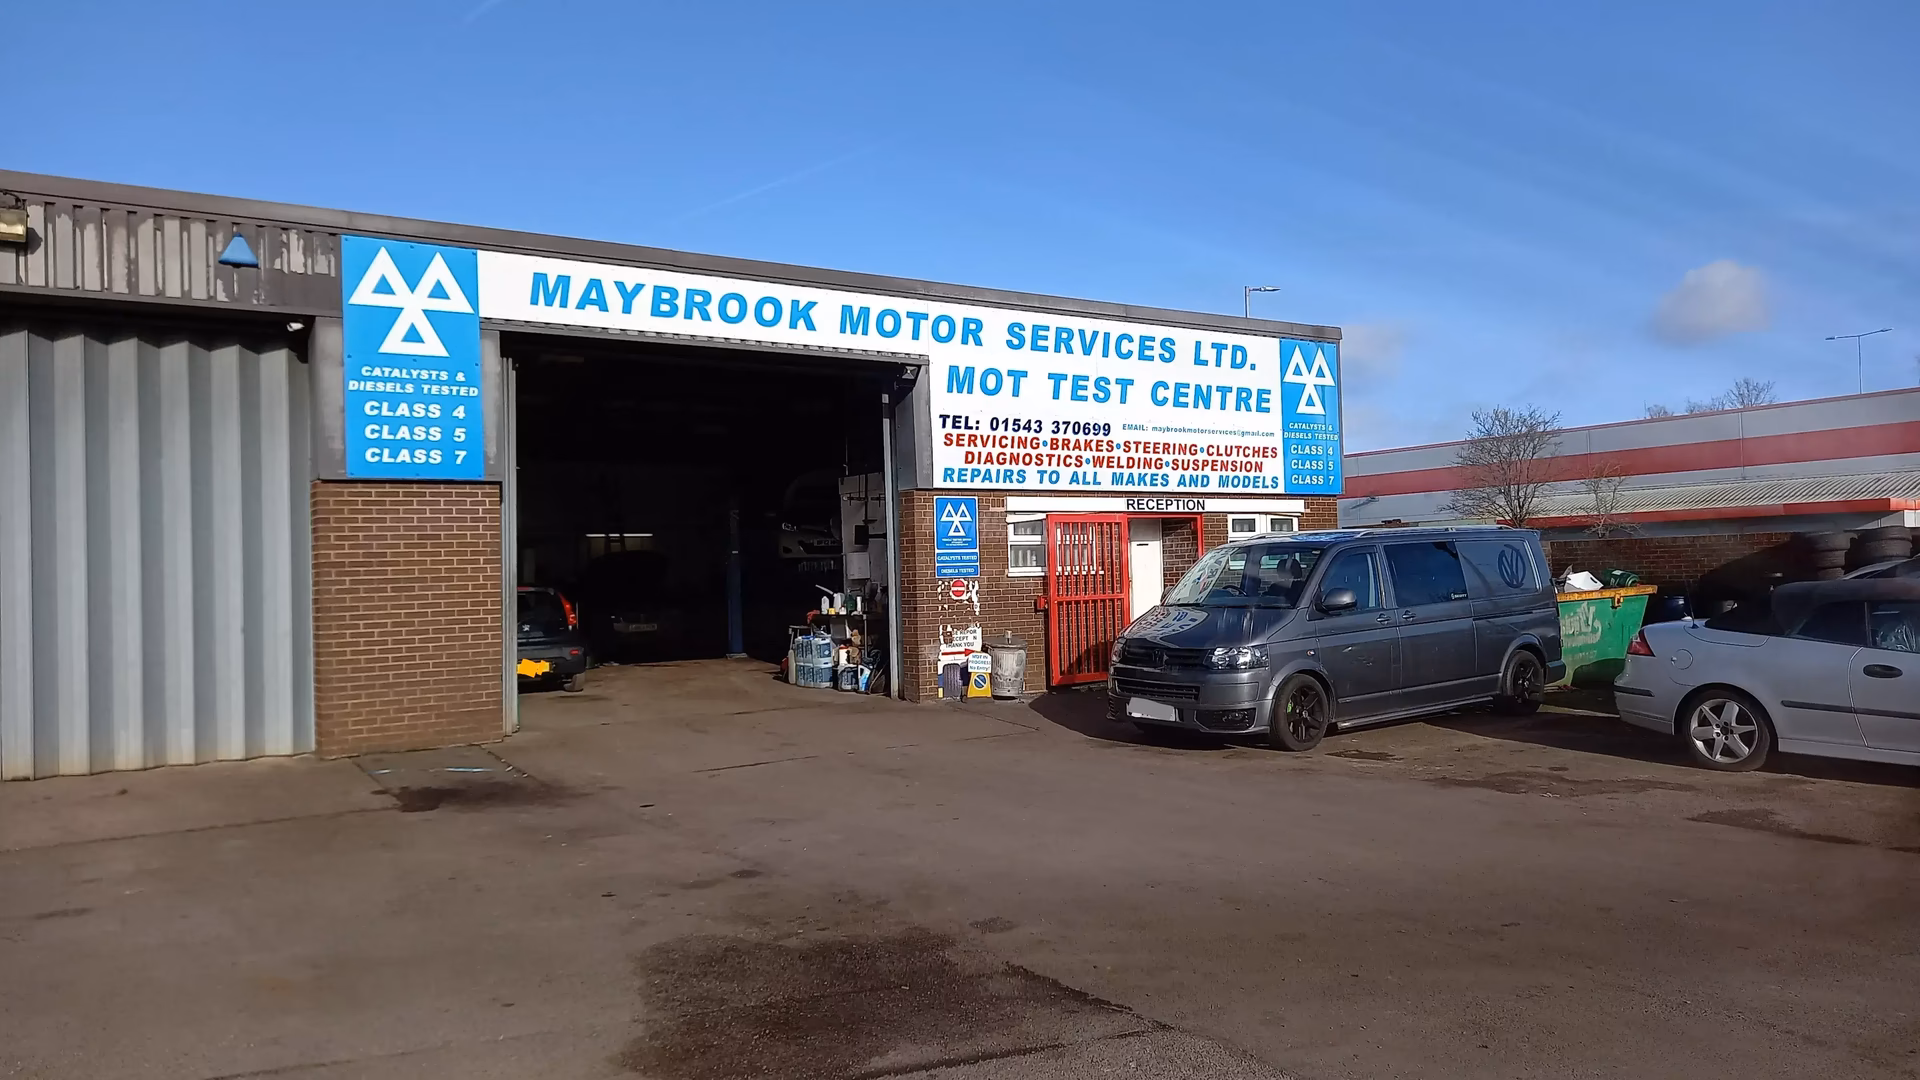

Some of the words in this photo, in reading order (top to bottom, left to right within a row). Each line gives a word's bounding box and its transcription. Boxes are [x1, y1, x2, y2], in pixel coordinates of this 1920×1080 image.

[529, 272, 818, 332] MAYBROOK
[840, 304, 983, 347] MOTOR
[1006, 322, 1176, 363] SERVICES
[1194, 340, 1256, 371] LTD.
[362, 366, 448, 380] CATALYSTS
[456, 372, 465, 381] &
[349, 381, 414, 393] DIESELS
[422, 385, 478, 396] TESTED
[947, 365, 1028, 398] MOT
[1047, 372, 1134, 404] TEST
[1150, 380, 1271, 413] CENTRE
[364, 401, 441, 418] CLASS
[453, 406, 465, 419] 4
[365, 424, 441, 441] CLASS
[454, 428, 466, 441] 5
[939, 414, 980, 430] TEL:
[990, 417, 1043, 434] 01543
[1051, 420, 1111, 437] 370699
[1122, 423, 1149, 431] EMAIL:
[943, 433, 1040, 450] SERVICING
[1050, 438, 1114, 453] BRAKES
[1123, 440, 1198, 456] STEERING
[1206, 444, 1277, 458] CLUTCHES
[1291, 445, 1323, 455] CLASS
[1328, 447, 1333, 455] 4
[366, 448, 442, 463] CLASS
[455, 451, 466, 464] 7
[964, 451, 1083, 468] DIAGNOSTICS
[1092, 455, 1163, 470] WELDING
[1171, 458, 1263, 473] SUSPENSION
[1292, 460, 1323, 470] CLASS
[1328, 461, 1333, 470] 5
[943, 467, 1026, 484] REPAIRS
[1037, 470, 1060, 485] TO
[1069, 471, 1101, 486] ALL
[1111, 472, 1169, 487] MAKES
[1177, 474, 1210, 488] AND
[1218, 475, 1279, 489] MODELS
[1292, 475, 1323, 484] CLASS
[1329, 476, 1334, 484] 7
[1126, 499, 1205, 511] RECEPTION
